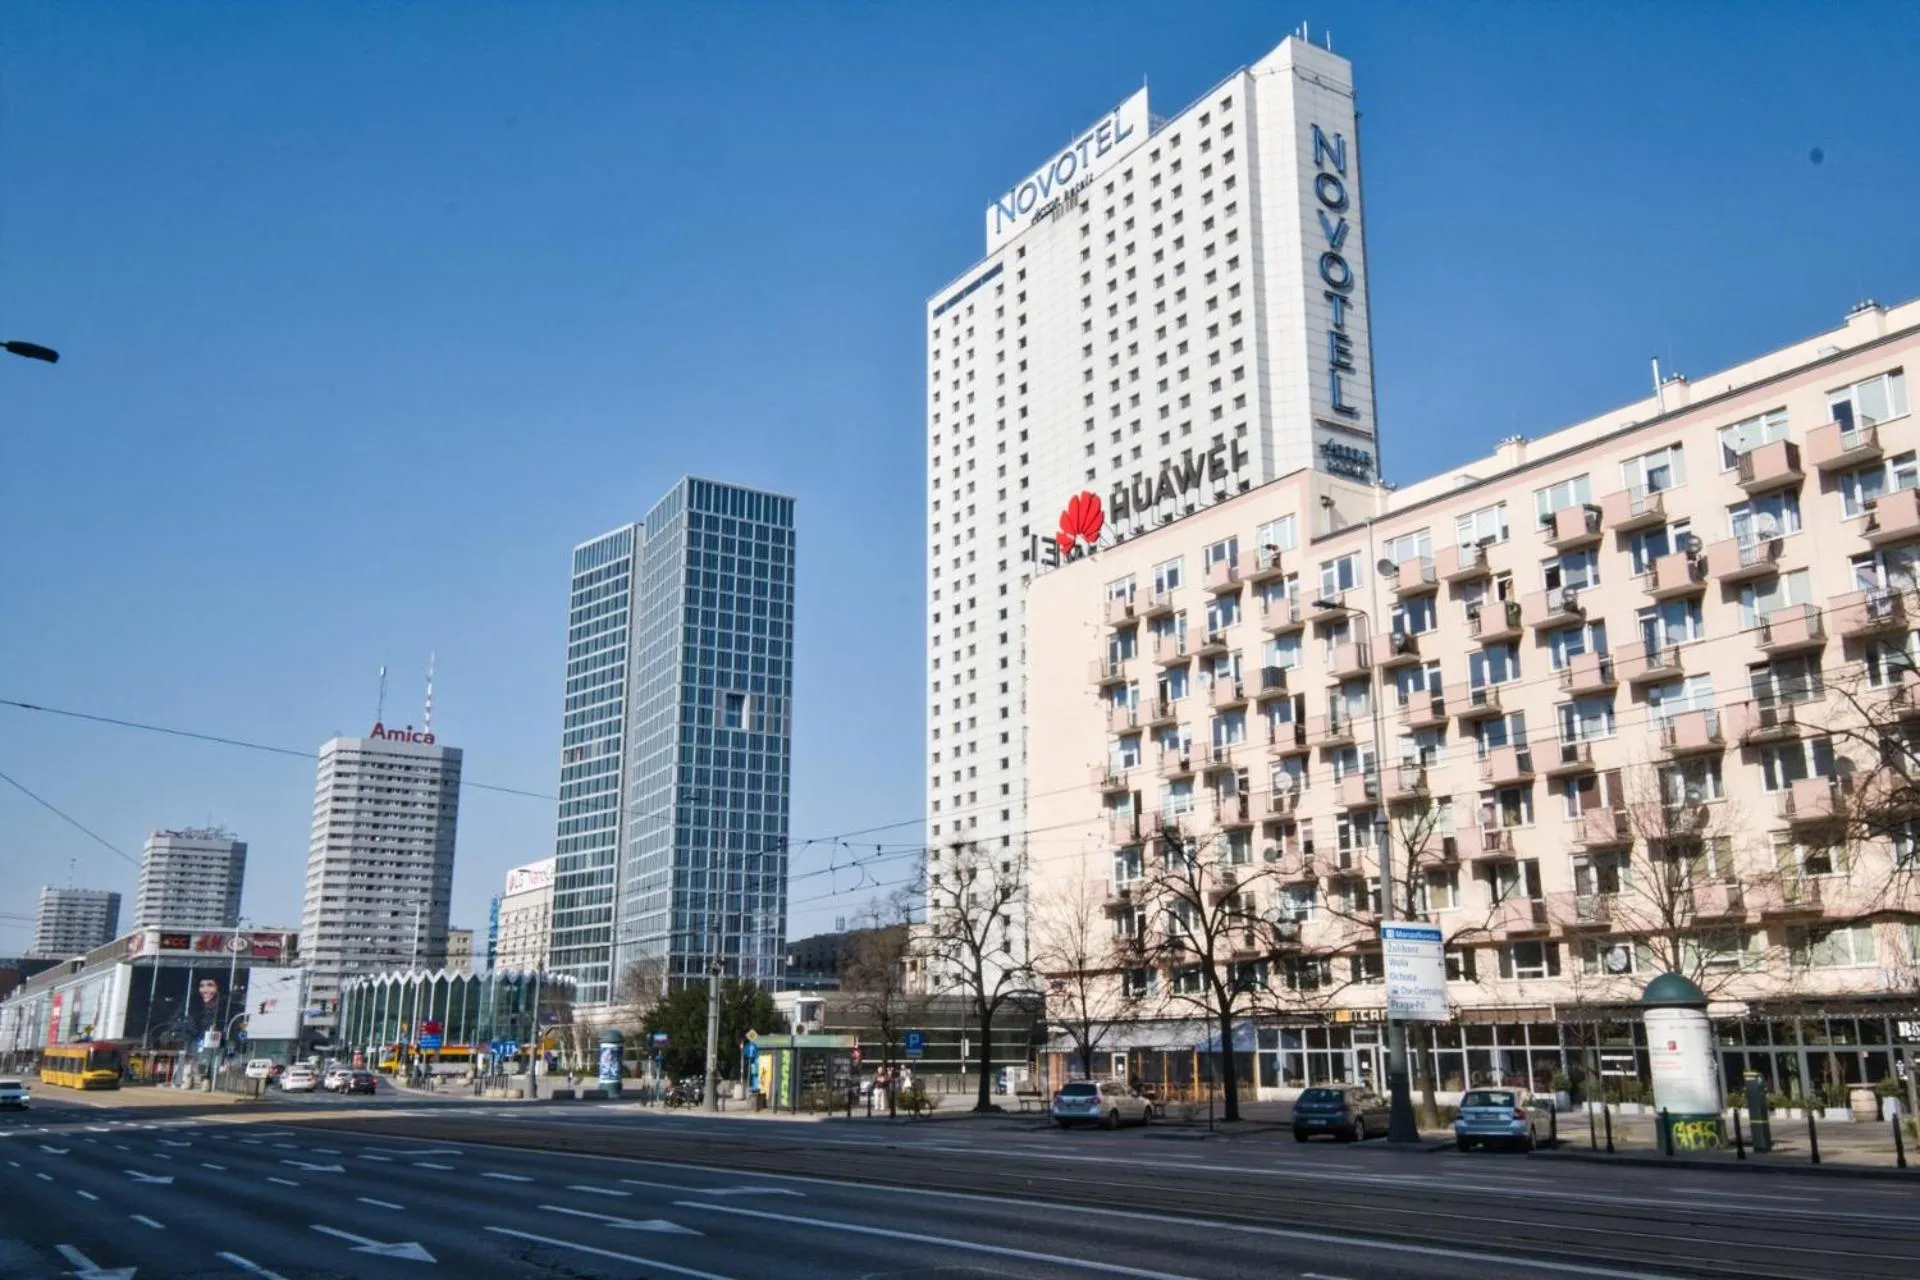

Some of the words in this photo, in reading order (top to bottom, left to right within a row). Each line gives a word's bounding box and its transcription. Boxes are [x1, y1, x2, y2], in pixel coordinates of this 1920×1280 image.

[994, 106, 1134, 234] NOVOTEL
[1311, 122, 1361, 419] NOVOTEL
[1109, 438, 1241, 525] HUAWEI
[370, 721, 435, 745] Amica
[909, 1033, 920, 1047] P
